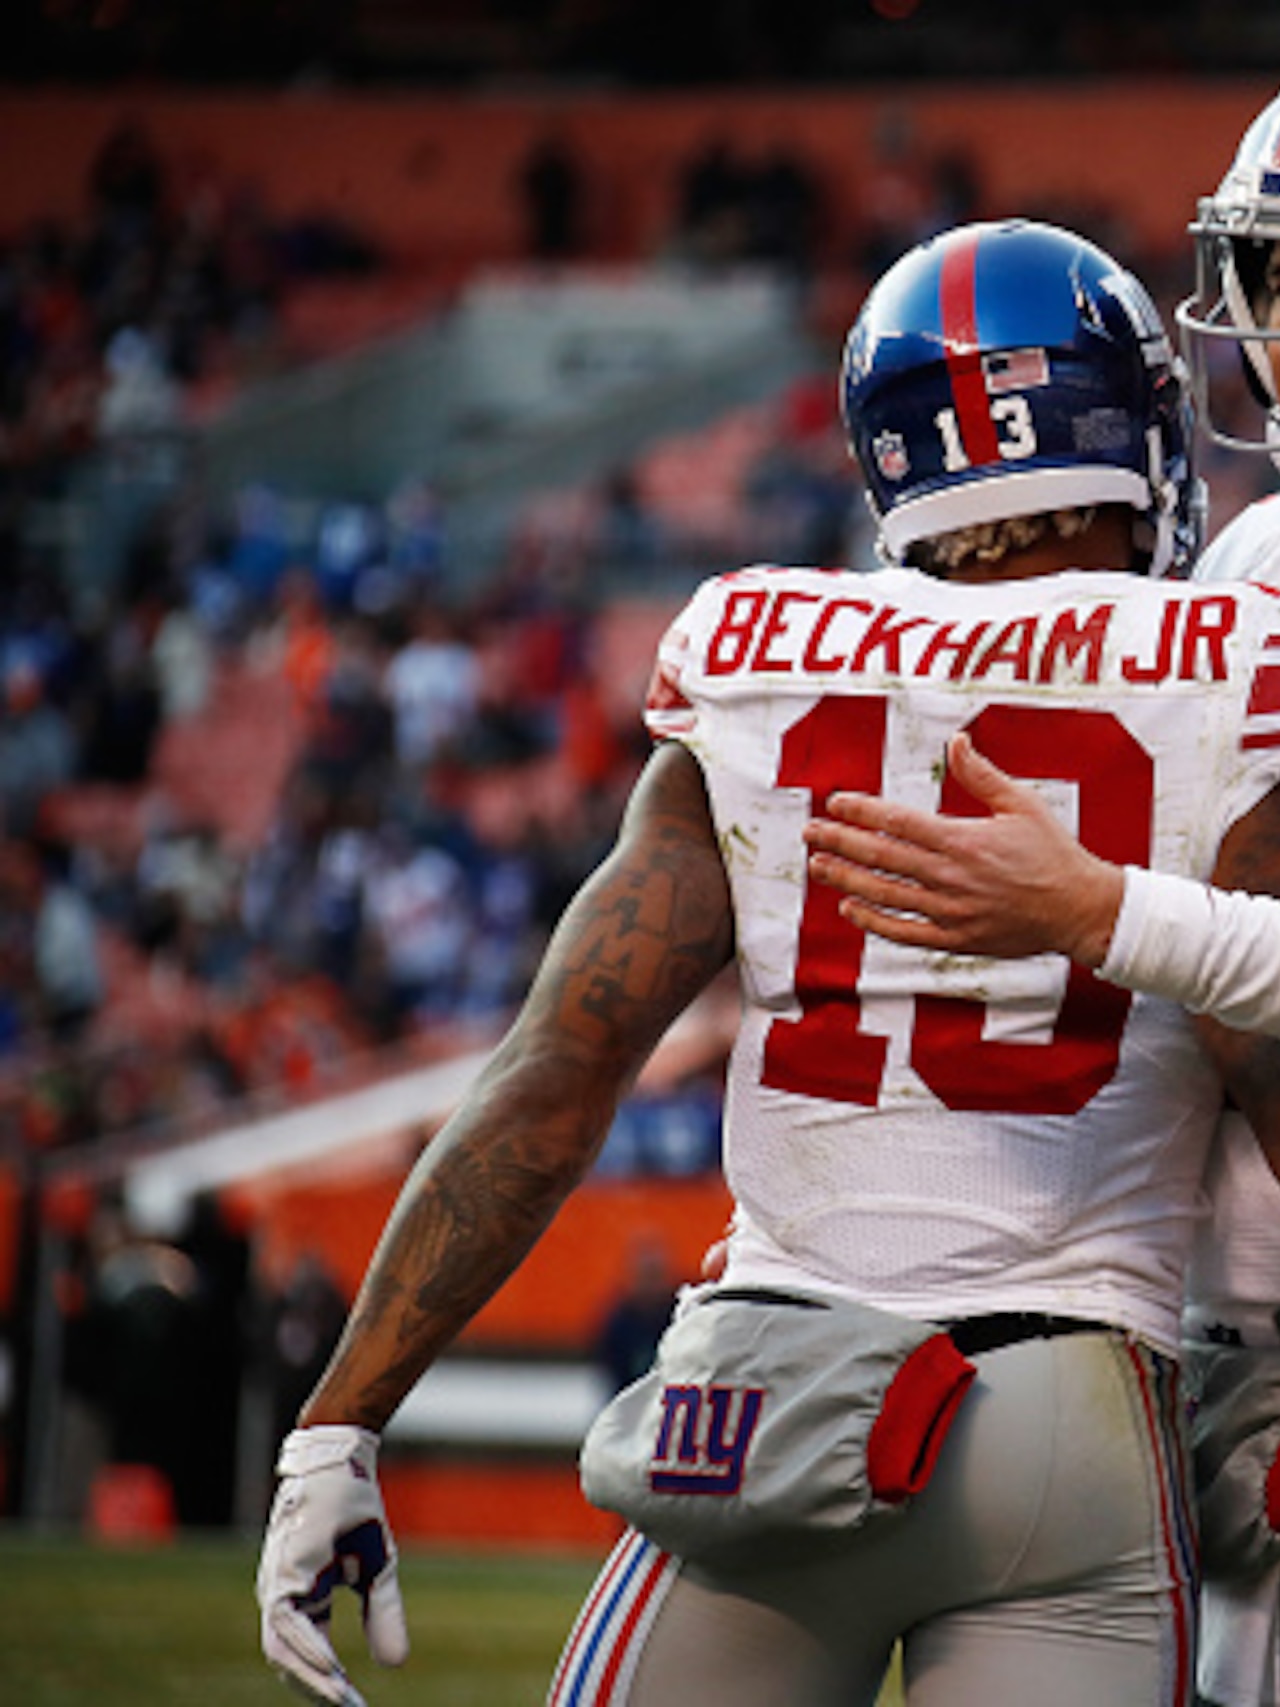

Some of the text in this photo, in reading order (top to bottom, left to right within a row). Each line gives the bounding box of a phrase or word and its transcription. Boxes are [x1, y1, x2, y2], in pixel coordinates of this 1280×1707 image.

[933, 396, 1037, 472] 13
[703, 590, 1238, 685] BECKHAM JR
[759, 694, 1155, 1115] 13
